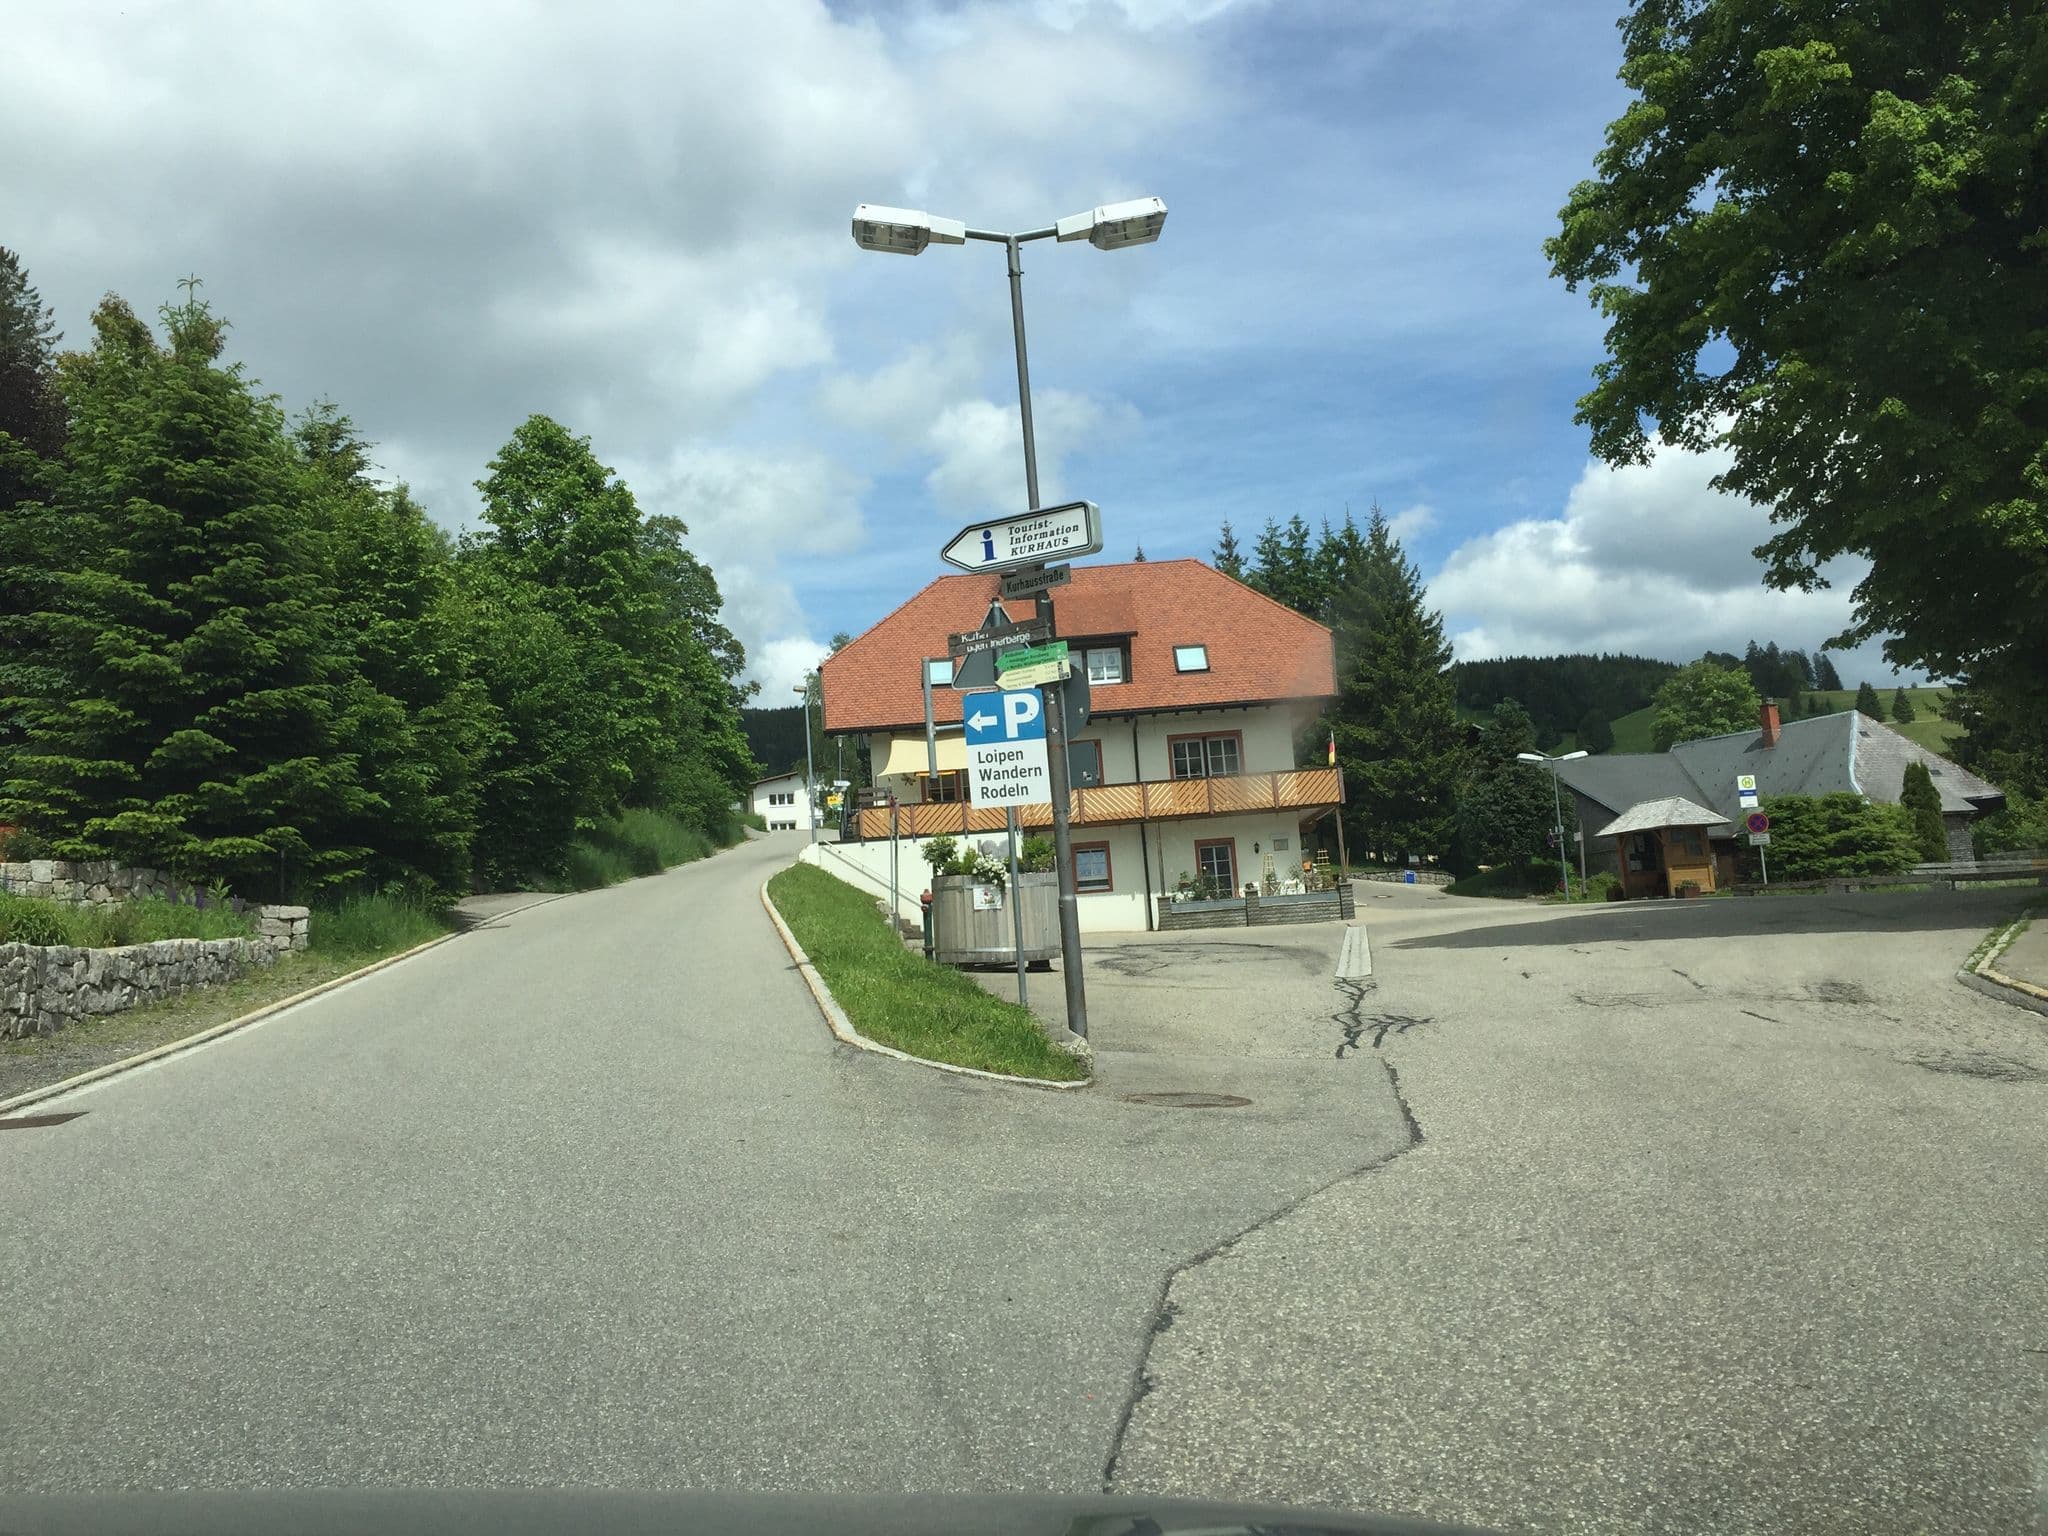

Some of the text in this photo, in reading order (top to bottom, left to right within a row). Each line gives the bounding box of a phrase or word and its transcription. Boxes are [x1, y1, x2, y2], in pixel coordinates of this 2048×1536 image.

[1008, 520, 1053, 536] Tourist-
[1010, 524, 1080, 546] Information
[1011, 536, 1070, 557] KURHAUS
[1006, 569, 1065, 594] Kurhausstraße
[1003, 692, 1040, 739] P
[977, 749, 1024, 765] Loipen
[978, 765, 1043, 782] Wandern
[980, 783, 1029, 800] Rodeln
